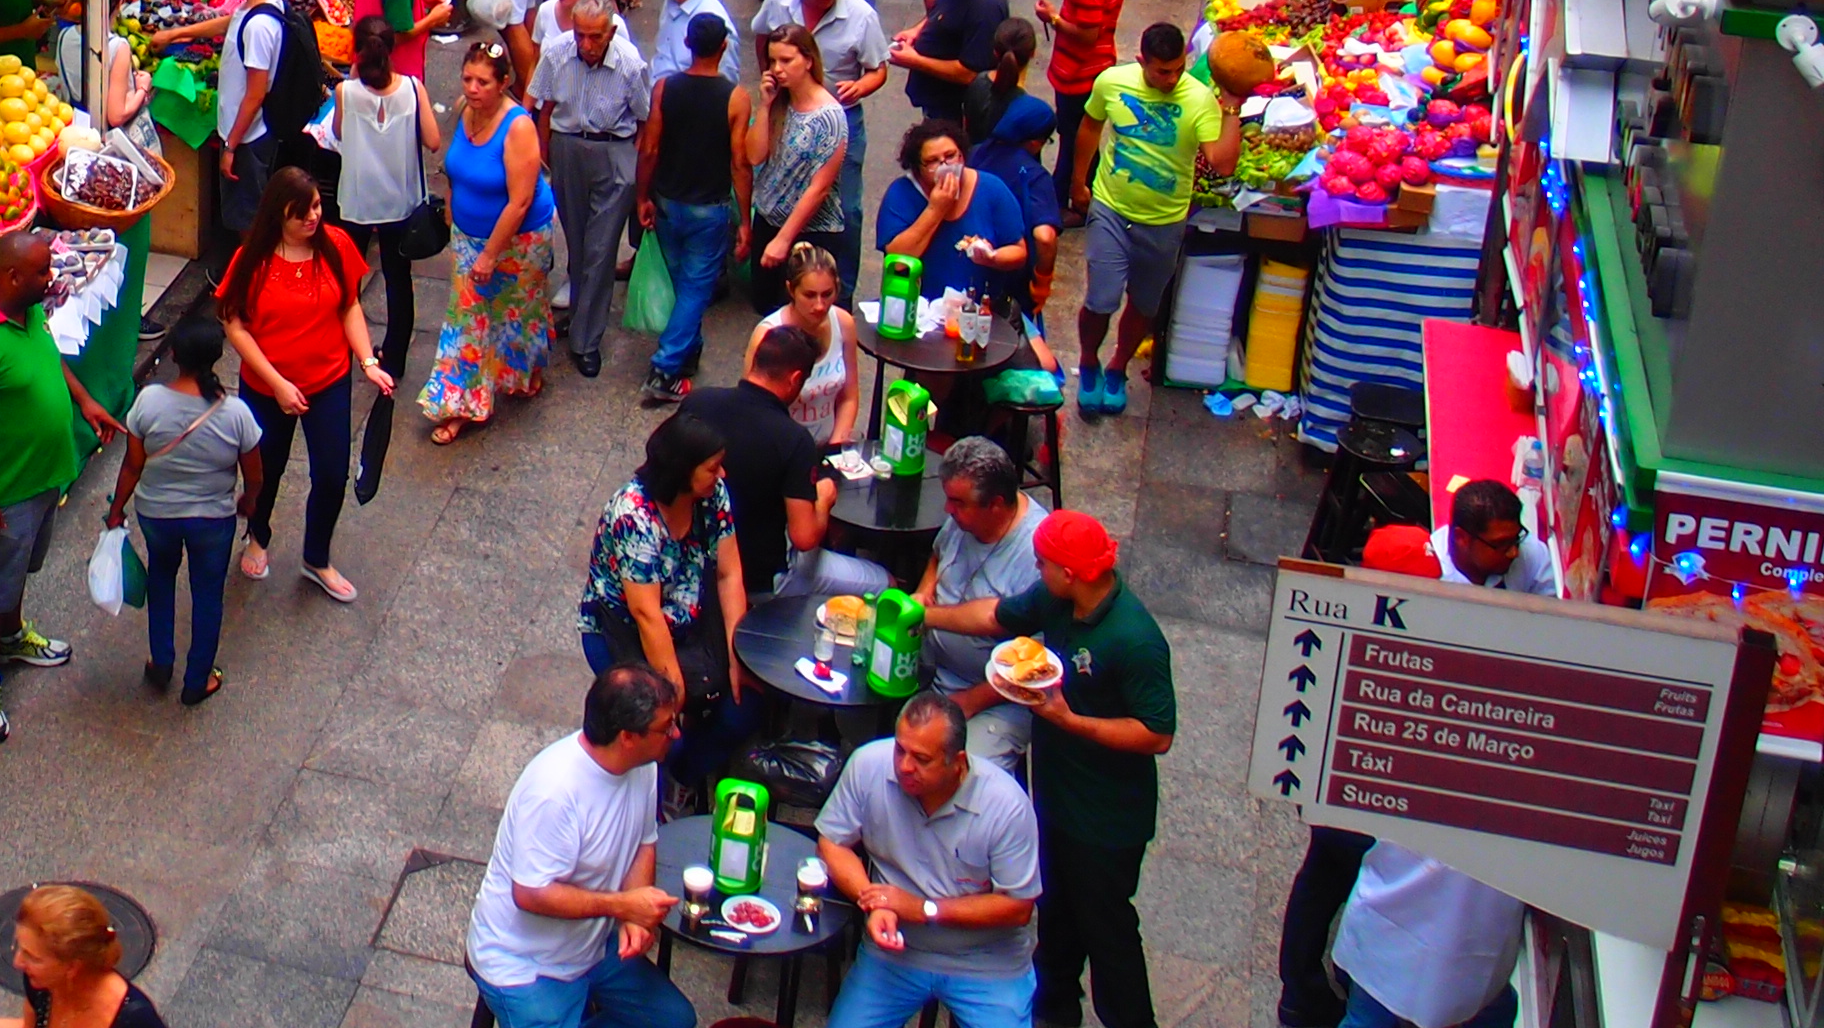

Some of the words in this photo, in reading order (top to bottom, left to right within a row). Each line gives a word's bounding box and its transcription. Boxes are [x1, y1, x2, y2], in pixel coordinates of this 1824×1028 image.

[1665, 512, 1824, 564] PERNI
[1289, 588, 1348, 620] Rua
[1372, 593, 1409, 630] K
[1364, 643, 1434, 672] Frutas
[1358, 678, 1402, 704] Rua
[1407, 688, 1435, 709] da
[1441, 693, 1556, 729] Cantareira
[1654, 700, 1695, 717] Frutas
[1660, 688, 1697, 703] Fruits
[1353, 711, 1397, 737] Rua
[1401, 720, 1429, 741] 25
[1433, 727, 1461, 747] de
[1466, 731, 1535, 761] Março
[1348, 748, 1394, 774] Táxi
[1342, 783, 1409, 812] Sucos
[1649, 797, 1675, 811] Taxi
[1647, 810, 1673, 825] Taxi
[1626, 829, 1667, 845] Juices
[1625, 843, 1665, 859] Jugos
